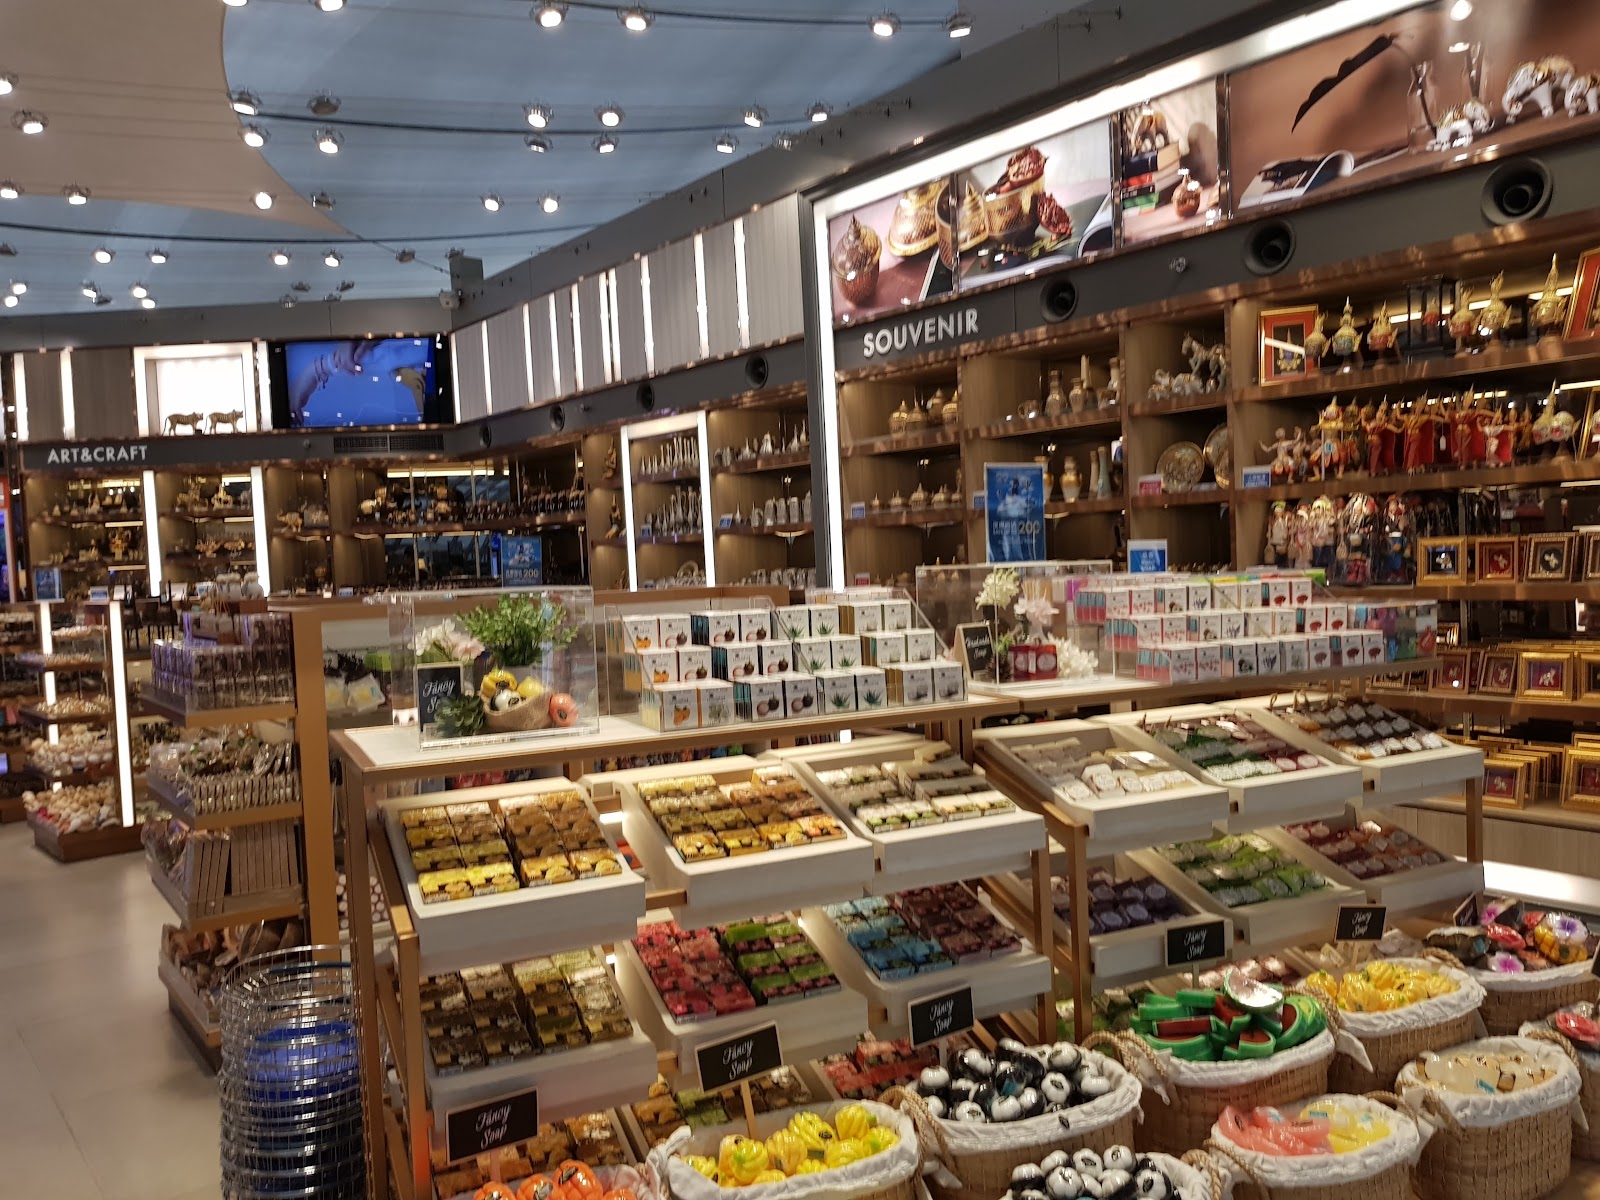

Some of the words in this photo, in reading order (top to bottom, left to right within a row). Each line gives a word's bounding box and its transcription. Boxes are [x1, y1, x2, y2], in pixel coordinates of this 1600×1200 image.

[863, 308, 978, 358] SOUVENIR
[47, 445, 147, 464] ART&CRAFT
[422, 679, 456, 698] Fancy
[722, 1039, 754, 1065] Fancy
[729, 1056, 753, 1081] Soap
[475, 1103, 511, 1132] Fancy
[480, 1124, 507, 1150] Soap
